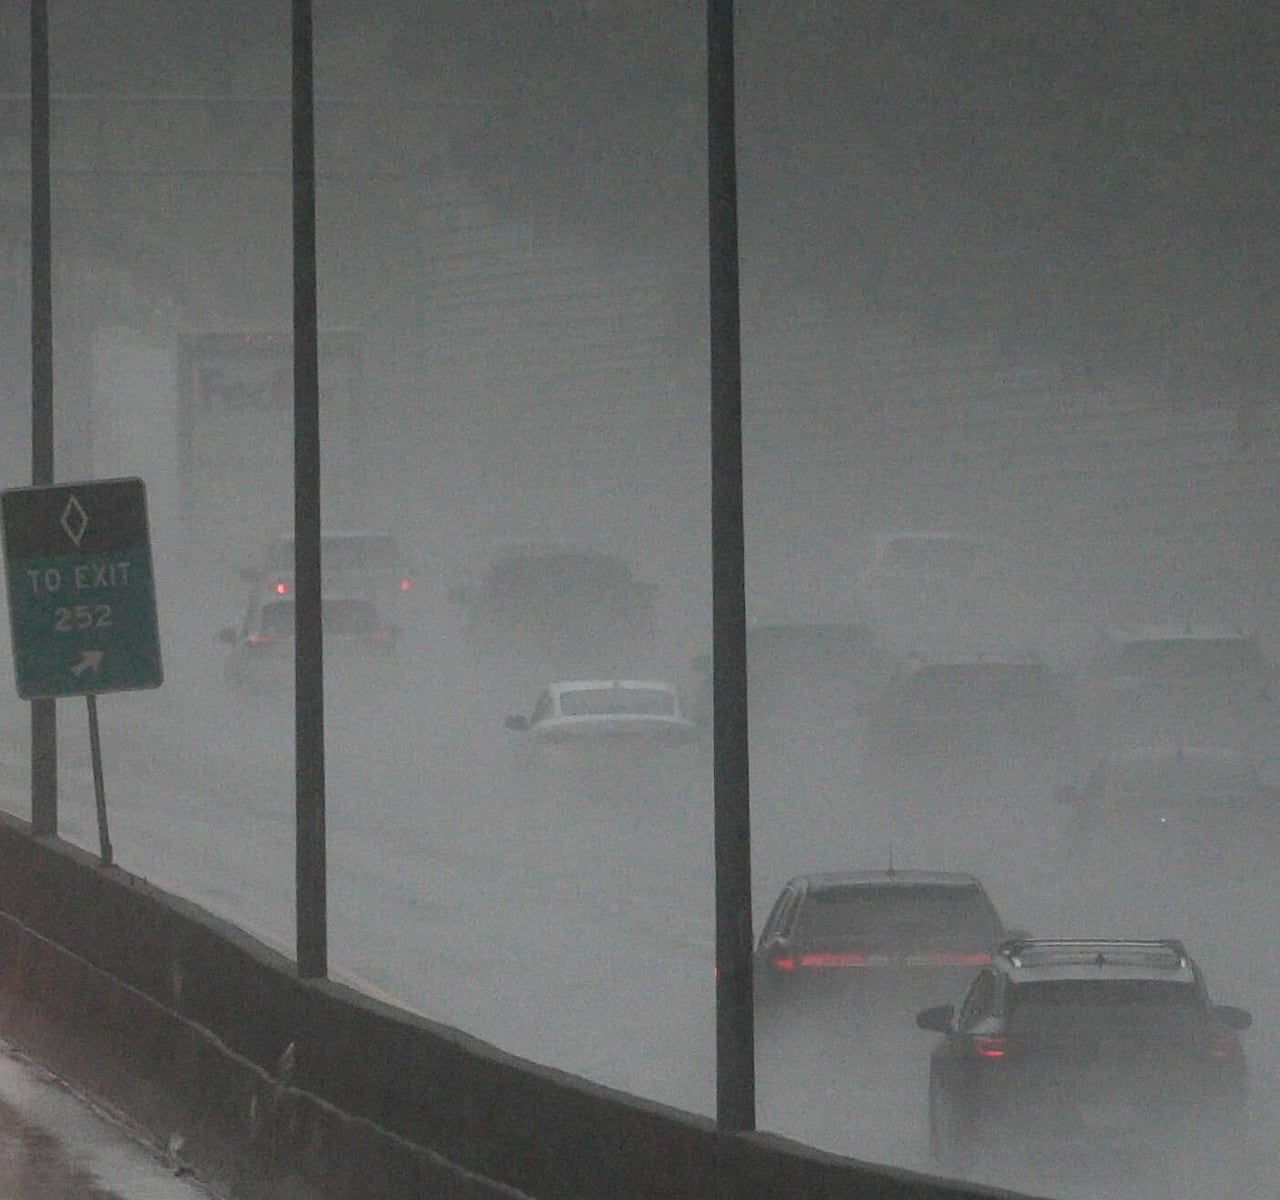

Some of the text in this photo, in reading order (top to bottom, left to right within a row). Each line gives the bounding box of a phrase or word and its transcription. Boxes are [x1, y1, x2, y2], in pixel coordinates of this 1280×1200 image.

[26, 561, 132, 595] TO EXIT
[54, 604, 113, 631] 252
